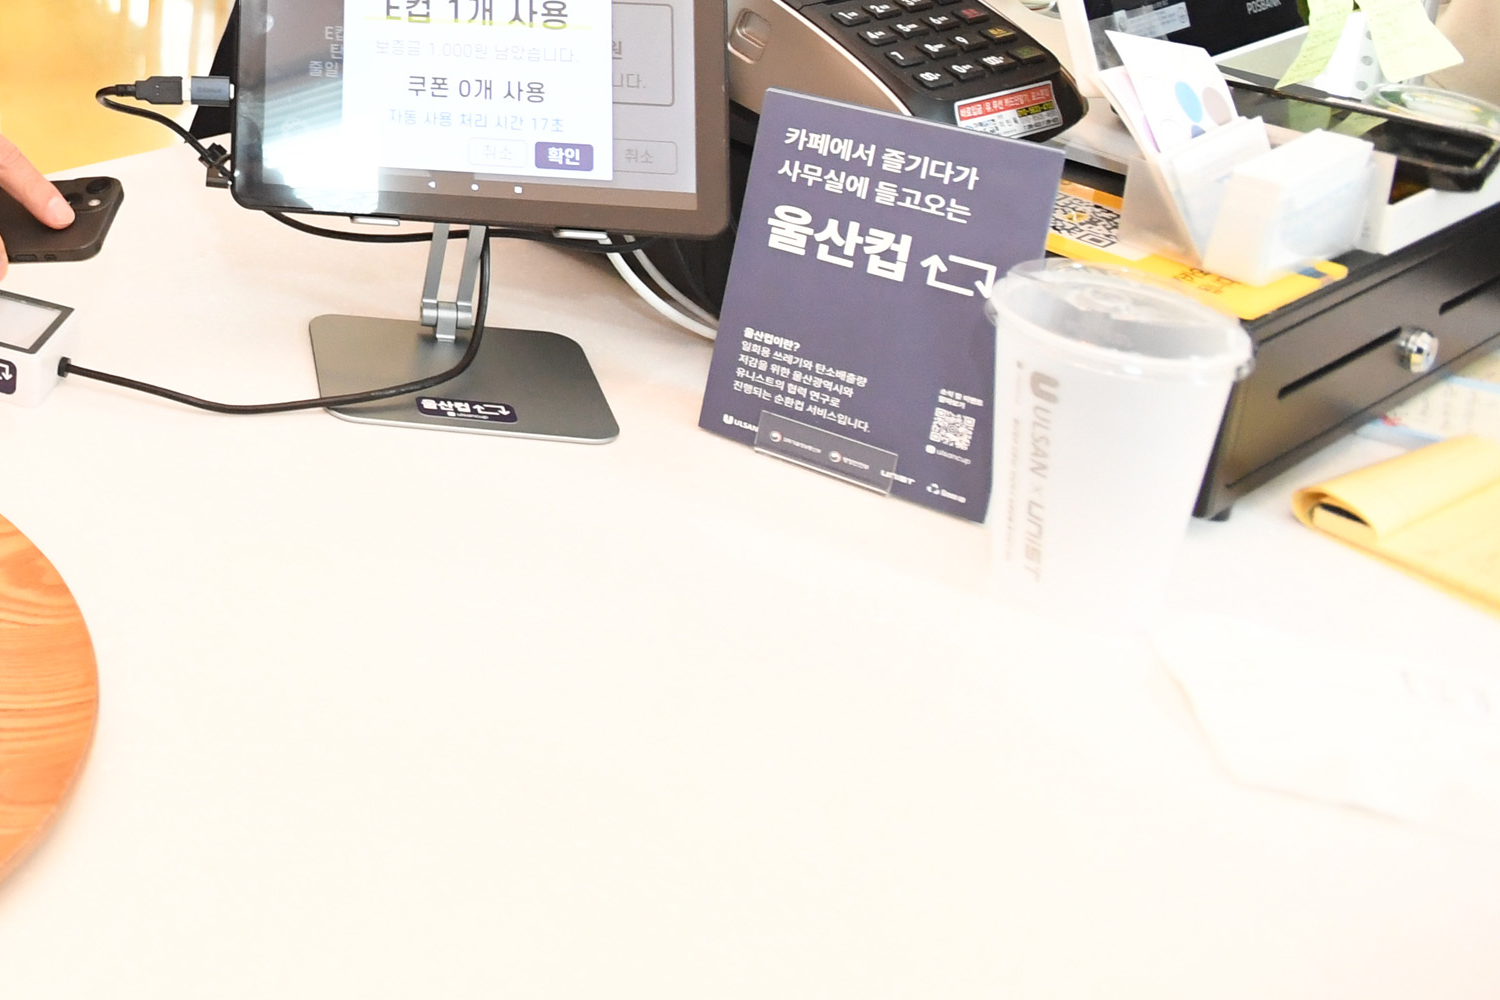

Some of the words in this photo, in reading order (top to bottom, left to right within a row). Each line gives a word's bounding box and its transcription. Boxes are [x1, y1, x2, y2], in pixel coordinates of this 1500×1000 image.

[375, 39, 422, 57] 보증금
[494, 44, 580, 64] 남았습니다.
[407, 75, 449, 99] 쿠폰
[458, 78, 493, 101] 0개
[503, 80, 546, 104] 사용
[389, 108, 418, 126] 자동
[424, 110, 453, 127] 사용
[459, 112, 488, 129] 처리
[494, 114, 524, 132] 시간
[531, 116, 565, 133] 17초
[482, 144, 514, 161] 취소
[548, 147, 580, 166] 확인
[624, 147, 654, 165] 취소
[784, 126, 876, 167] 카페에서
[881, 147, 980, 191] 즐기다가
[777, 160, 870, 199] 사무실에
[874, 180, 972, 224] 들고오는
[767, 203, 912, 283] 울산컵
[743, 326, 802, 353] 울산컵이란?
[737, 353, 768, 372] 저감을
[770, 363, 791, 379] 위한
[792, 370, 854, 399] 울산광역시와
[741, 340, 772, 359] 일회용
[772, 350, 814, 371] 쓰레기와
[814, 362, 868, 388] 탄소배출량
[421, 398, 471, 413] 울산컵
[735, 366, 786, 392] 유니스트의
[787, 381, 809, 397] 협력
[809, 389, 841, 409] 연구로
[732, 379, 773, 401] 진행되는
[773, 393, 805, 412] 순환컵
[805, 402, 871, 434] 서비스입니다.
[733, 418, 759, 433] ULSAN
[1029, 405, 1052, 479] ULSAN
